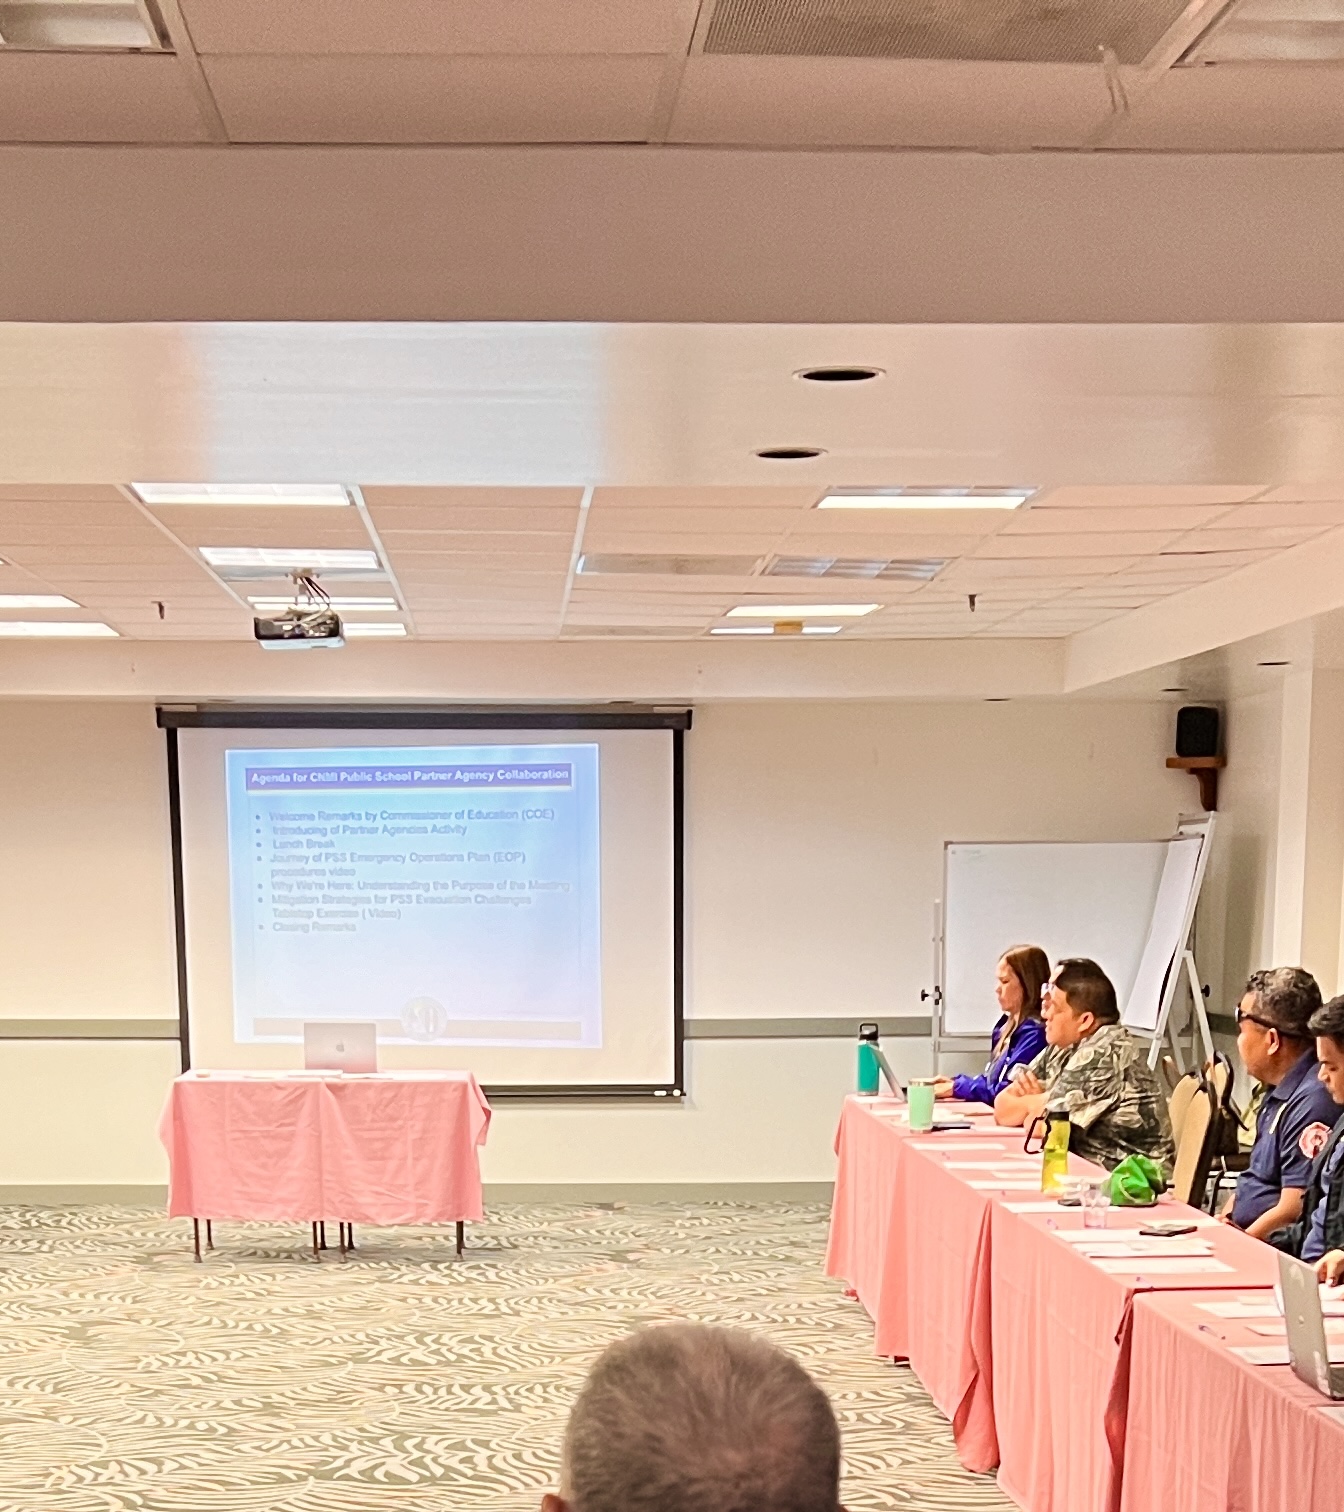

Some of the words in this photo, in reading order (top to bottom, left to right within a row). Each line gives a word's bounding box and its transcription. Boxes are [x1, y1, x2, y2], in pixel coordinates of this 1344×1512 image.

[251, 773, 291, 785] Agenda
[293, 773, 307, 782] for
[340, 772, 372, 782] Public
[375, 771, 411, 781] School
[413, 771, 452, 781] Partner
[455, 770, 495, 782] Agency
[497, 769, 569, 780] Collaboration
[269, 811, 315, 821] Welcome
[318, 811, 362, 821] Remarks
[365, 811, 377, 823] by
[380, 810, 452, 821] Commissioner
[455, 810, 465, 820] of
[467, 809, 518, 820] Education
[522, 809, 555, 821] (COE)
[273, 825, 327, 836] Introducing
[330, 825, 340, 835] of
[342, 825, 379, 835] Partner
[382, 825, 428, 836] Agencies
[431, 824, 467, 836] Activity
[273, 839, 304, 849] Lunch
[306, 839, 335, 849] Break
[270, 853, 309, 865] Journey
[312, 853, 322, 862] of
[325, 852, 347, 863] PSS
[350, 852, 406, 864] Emergency
[468, 852, 490, 862] Plan
[493, 851, 526, 864] (EOP)
[329, 866, 356, 876] video
[271, 881, 294, 892] Why
[357, 881, 430, 892] Understanding
[433, 880, 449, 890] the
[452, 880, 494, 892] Purpose
[497, 880, 507, 890] of
[510, 880, 526, 890] the
[374, 894, 388, 904] for
[390, 894, 413, 904] PSS
